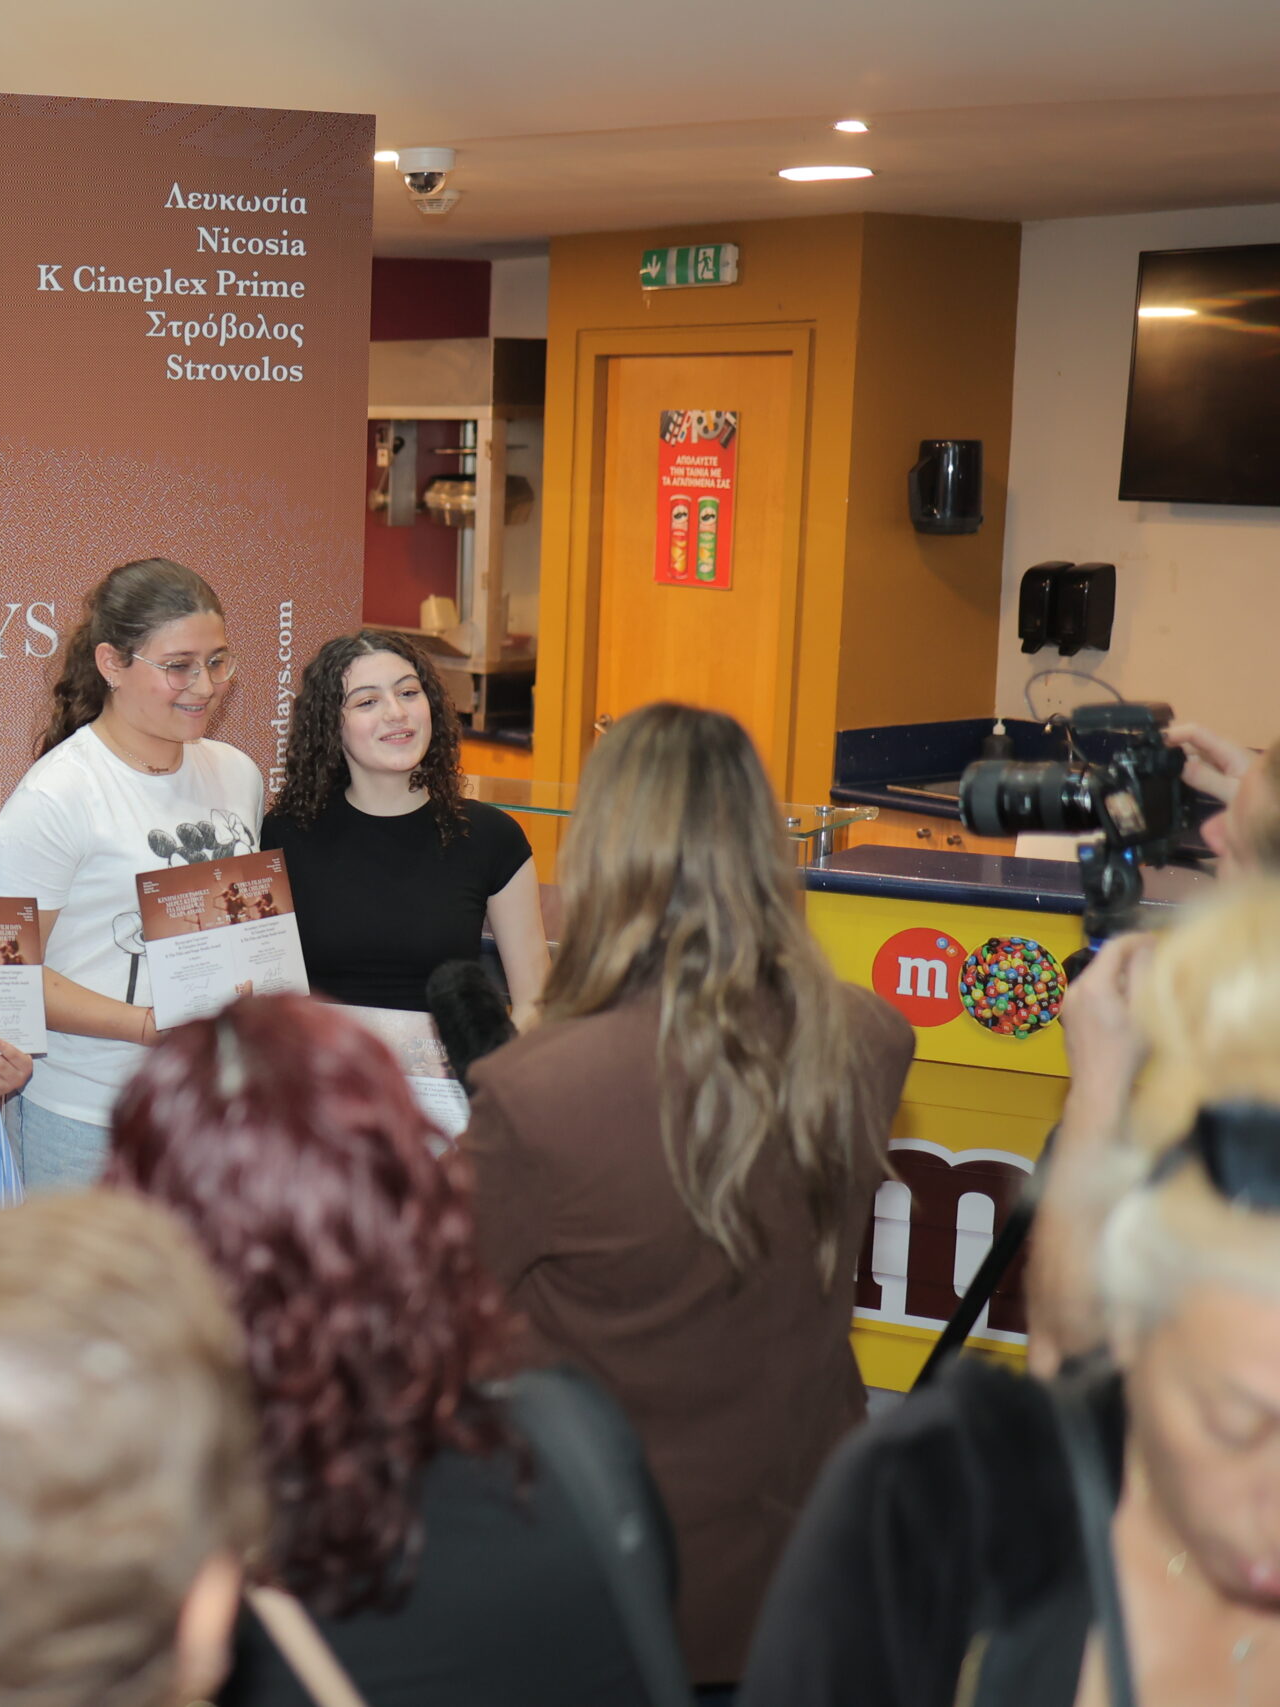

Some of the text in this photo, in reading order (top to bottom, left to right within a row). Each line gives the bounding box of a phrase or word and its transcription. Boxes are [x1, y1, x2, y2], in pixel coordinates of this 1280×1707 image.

[165, 183, 306, 213] Λευκωσία
[197, 227, 306, 256] Nicosia
[37, 264, 306, 302] K Cineplex Prime
[146, 310, 304, 348] Στρόβολος
[165, 354, 304, 383] Strovolos
[895, 955, 949, 1000] m
